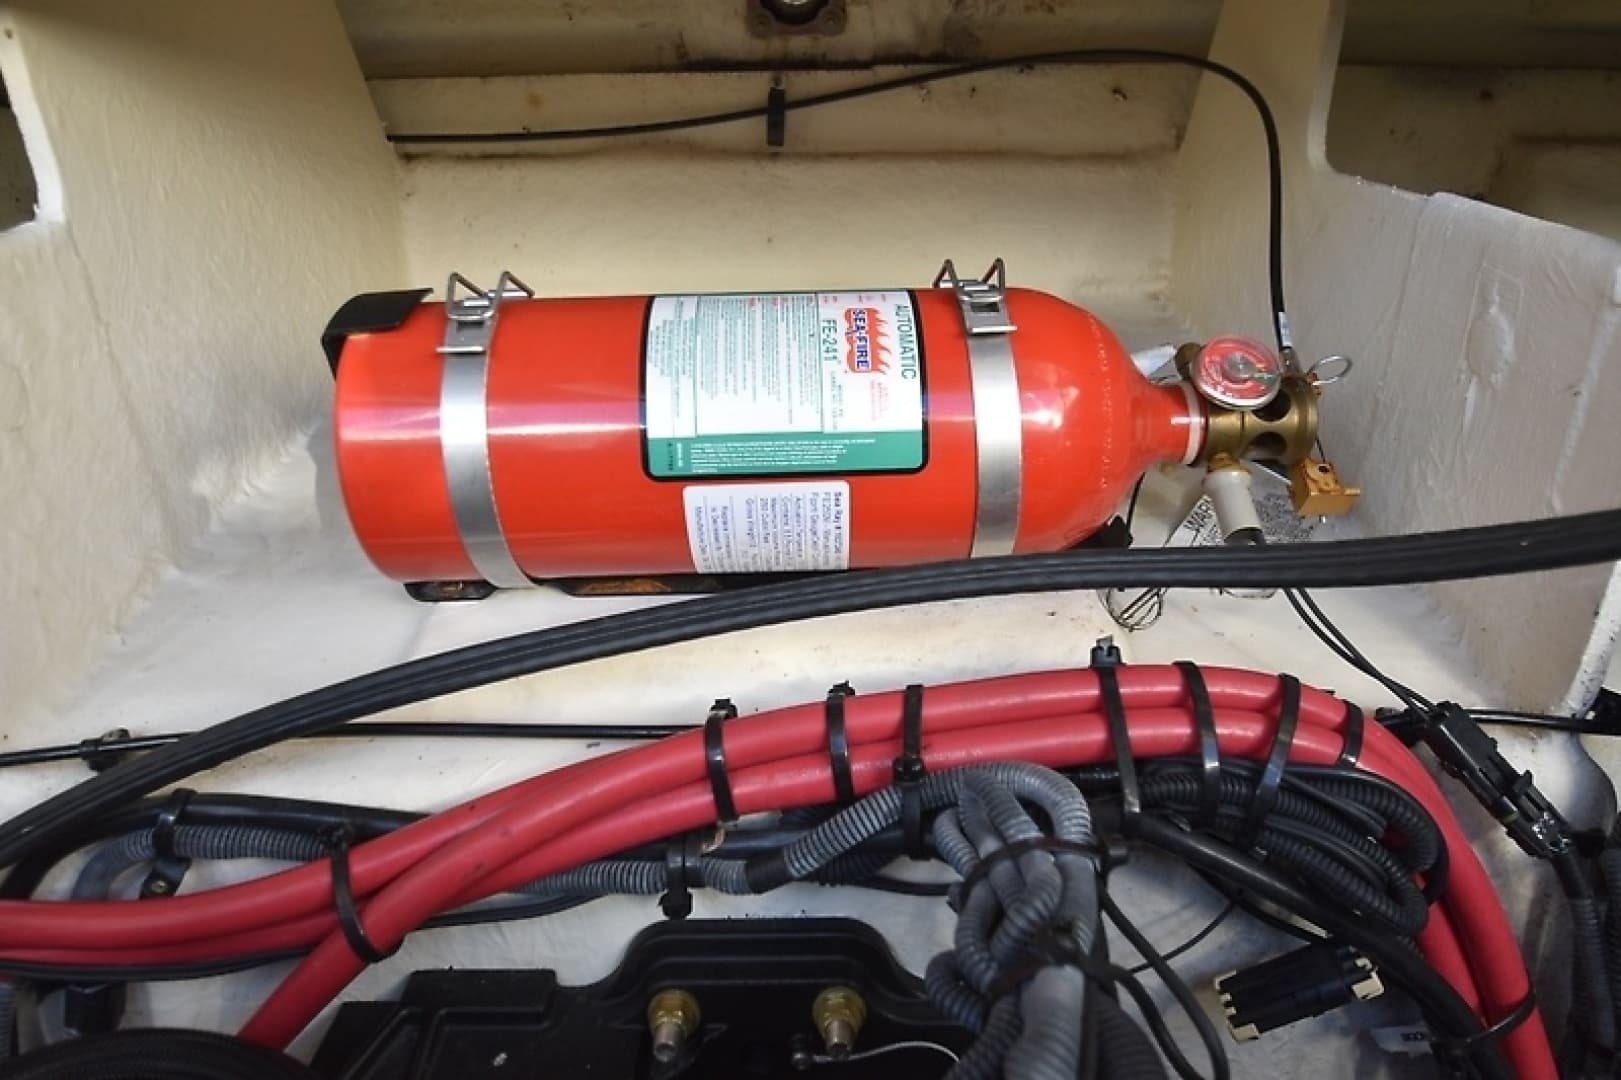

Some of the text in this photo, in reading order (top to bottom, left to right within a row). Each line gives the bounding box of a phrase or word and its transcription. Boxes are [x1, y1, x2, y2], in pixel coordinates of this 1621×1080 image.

[822, 319, 838, 361] FE-241
[852, 308, 870, 370] SEA-FIRE
[895, 304, 917, 380] AUTOMATIC
[833, 510, 843, 524] Ray
[834, 492, 842, 507] Sea
